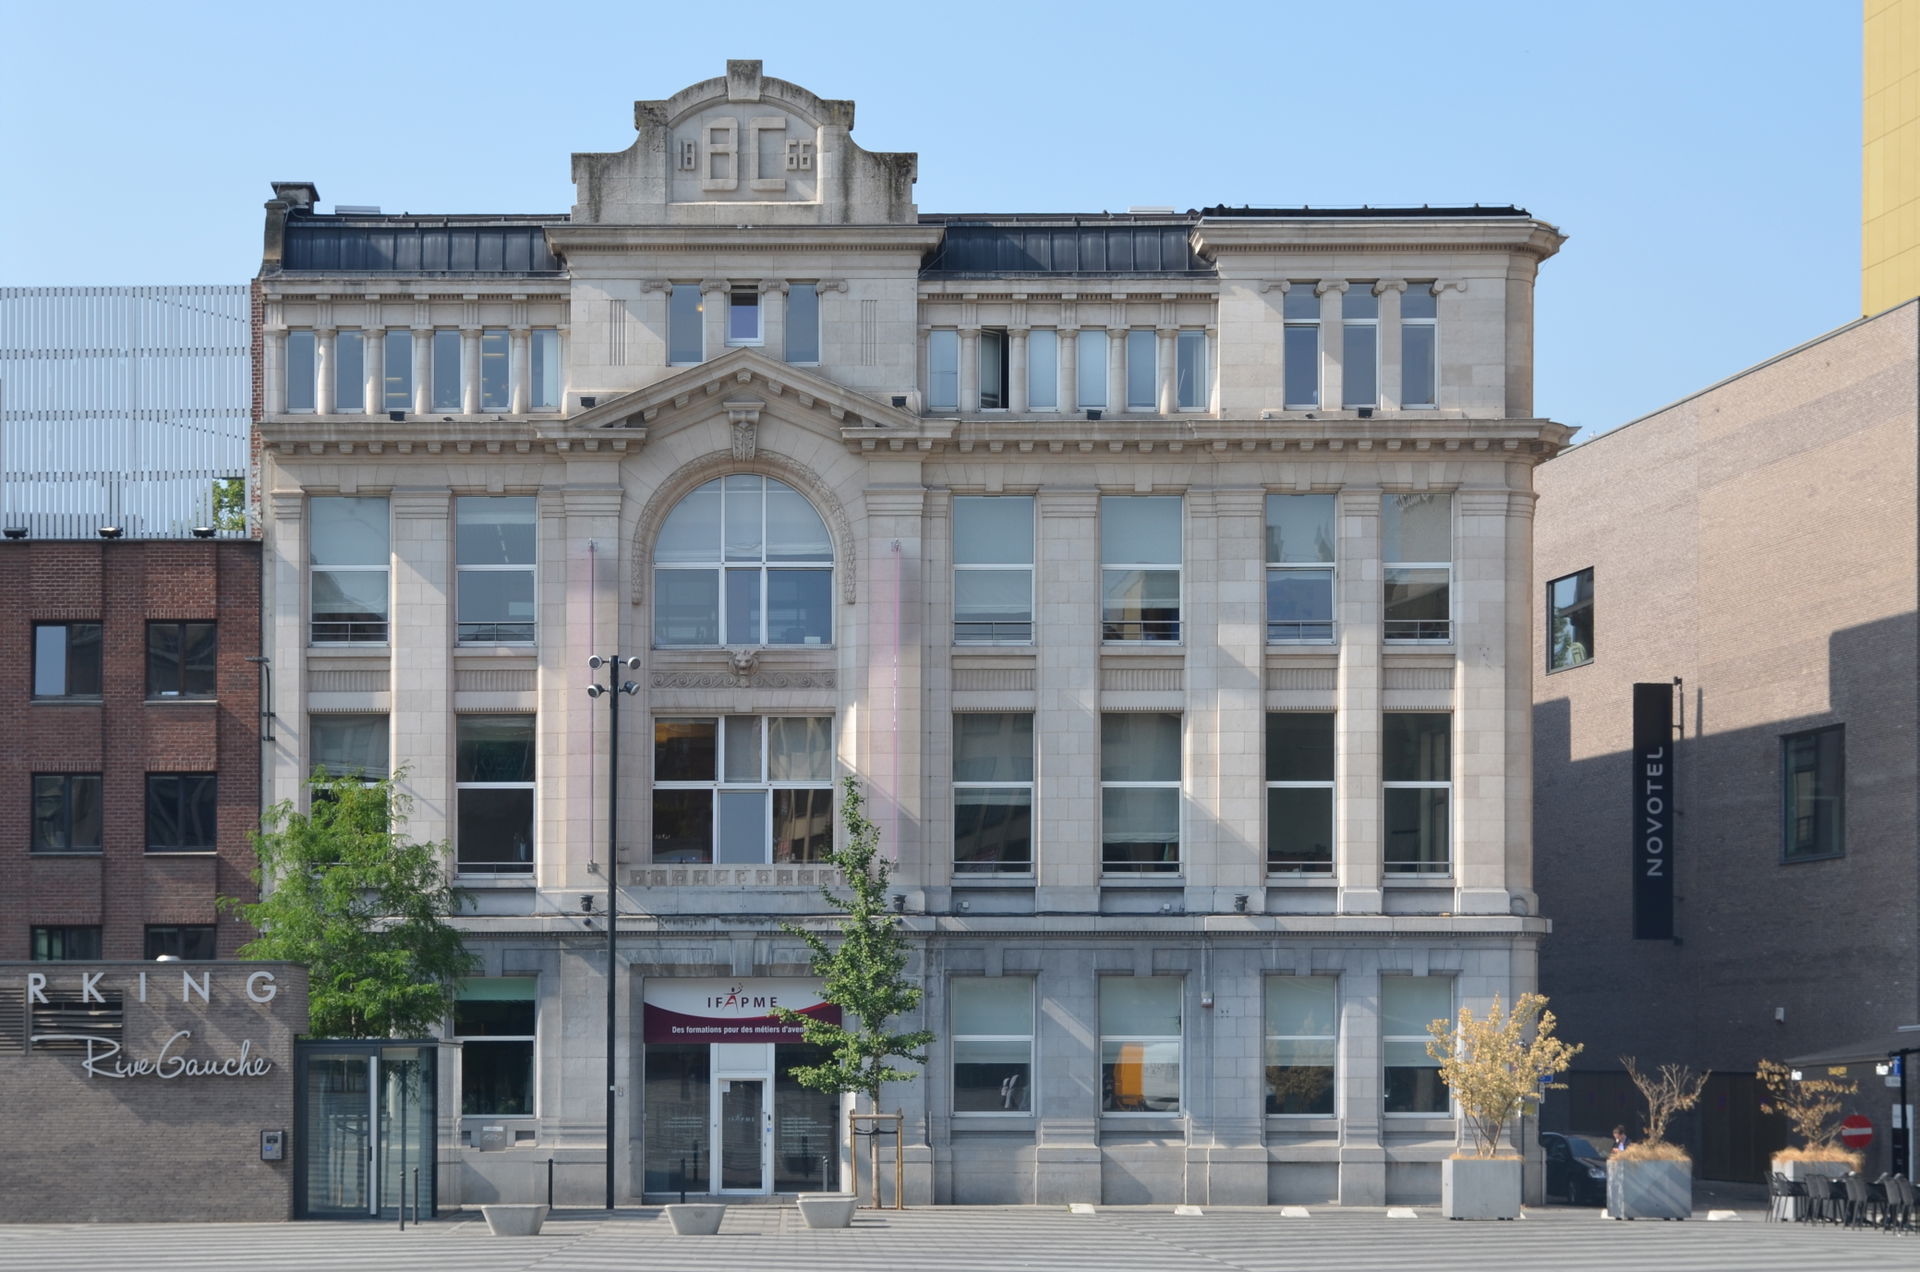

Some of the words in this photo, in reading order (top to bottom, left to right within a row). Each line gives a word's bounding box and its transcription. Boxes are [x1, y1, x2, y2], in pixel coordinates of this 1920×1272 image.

[1646, 746, 1664, 877] NOVOTEL
[27, 970, 278, 1004] RKING
[707, 994, 778, 1011] IFAPME
[672, 1025, 685, 1034] Des
[686, 1025, 722, 1034] formations
[723, 1026, 739, 1036] pour
[740, 1025, 753, 1034] des
[754, 1025, 780, 1034] métiers
[30, 1034, 157, 1079] Rive
[156, 1030, 272, 1079] Gauche
